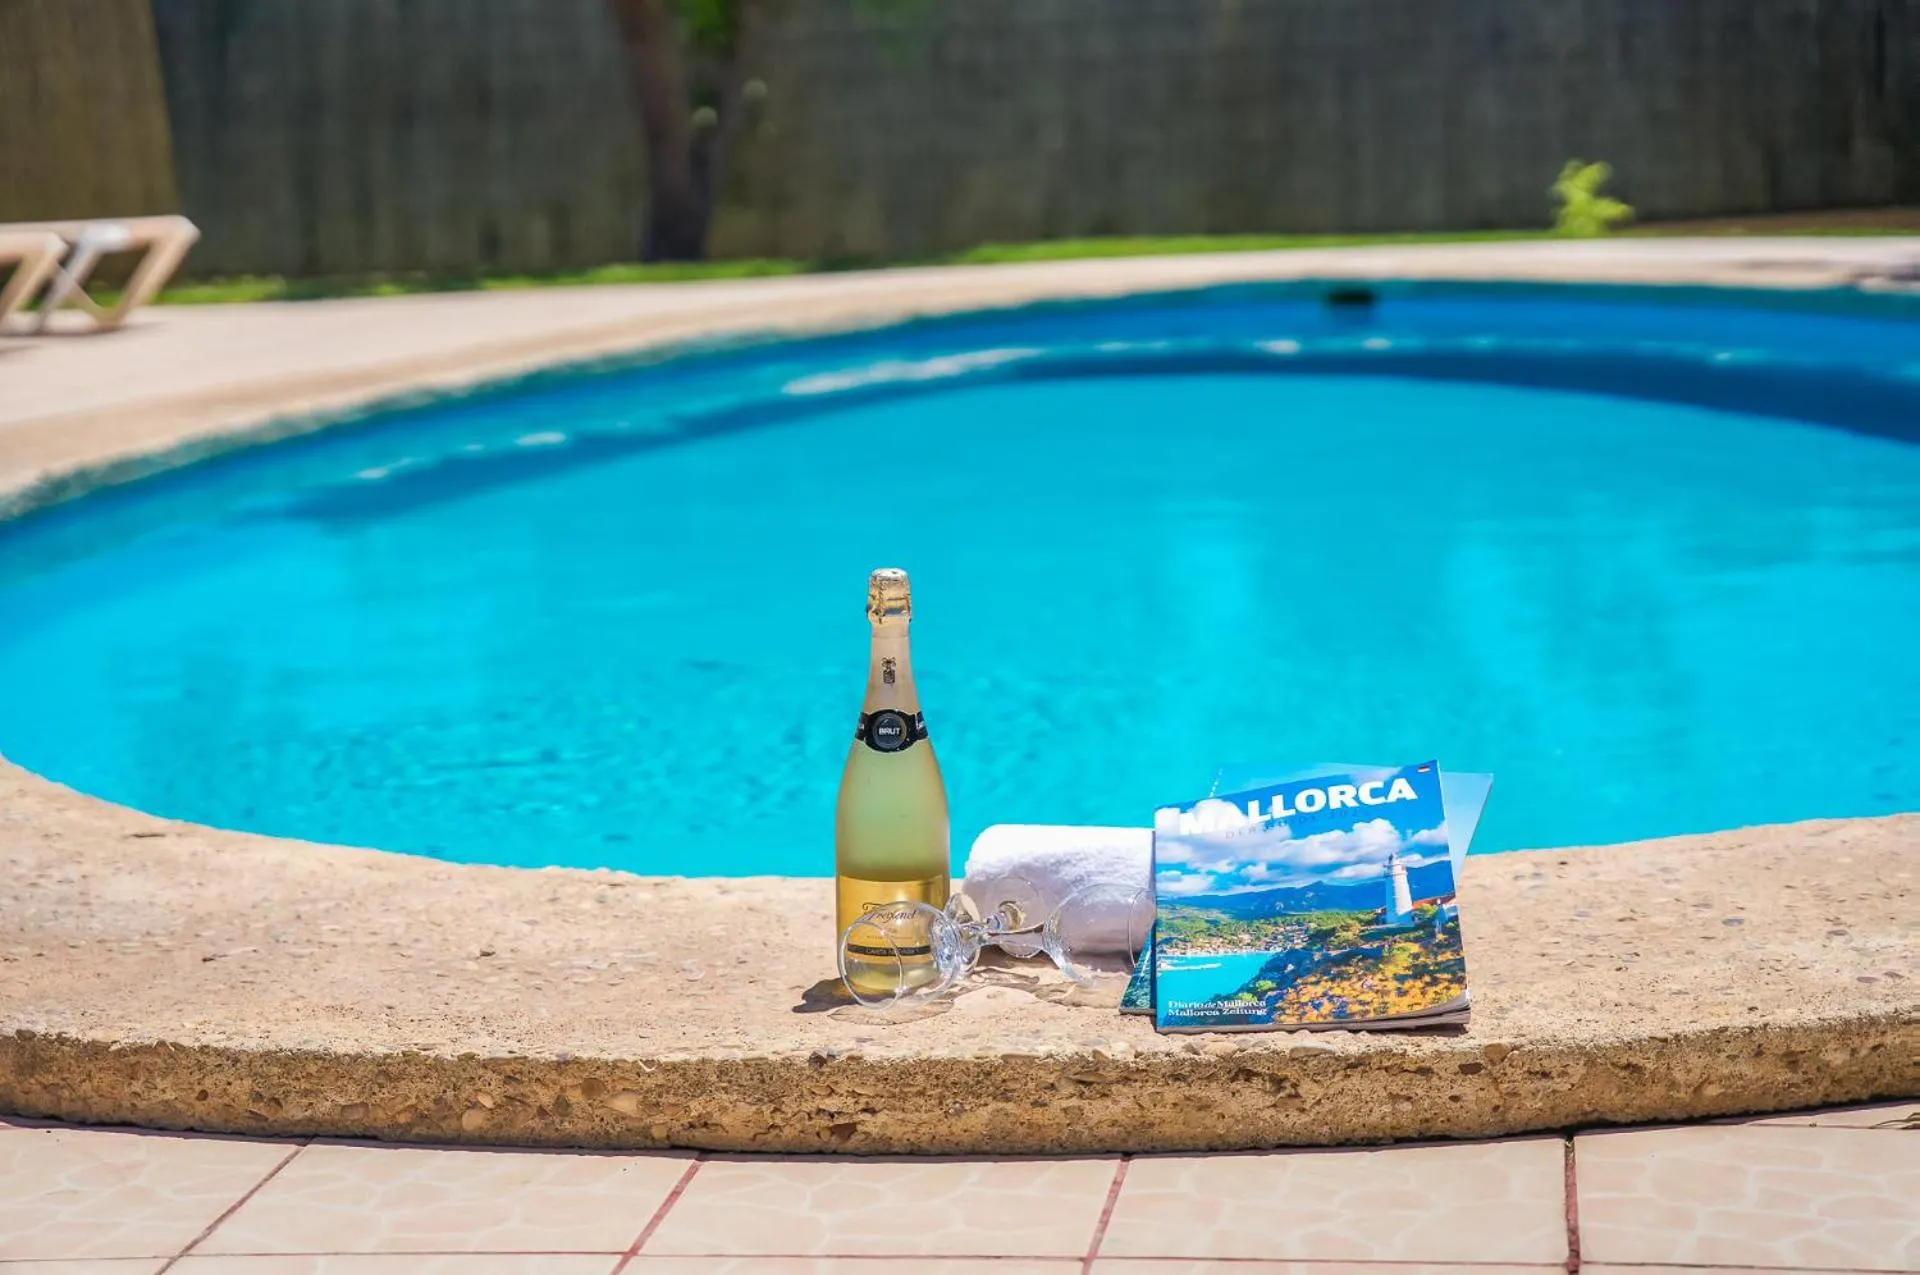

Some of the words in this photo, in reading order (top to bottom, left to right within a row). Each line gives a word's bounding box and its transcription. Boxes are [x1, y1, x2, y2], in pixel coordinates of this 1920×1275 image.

[878, 727, 901, 736] BRUT
[1180, 777, 1418, 836] MALLORCA
[1168, 1000, 1204, 1009] Diario
[1216, 1000, 1267, 1008] Mallorca
[1167, 1008, 1220, 1017] Mallorca
[1222, 1008, 1268, 1016] Zeitung
